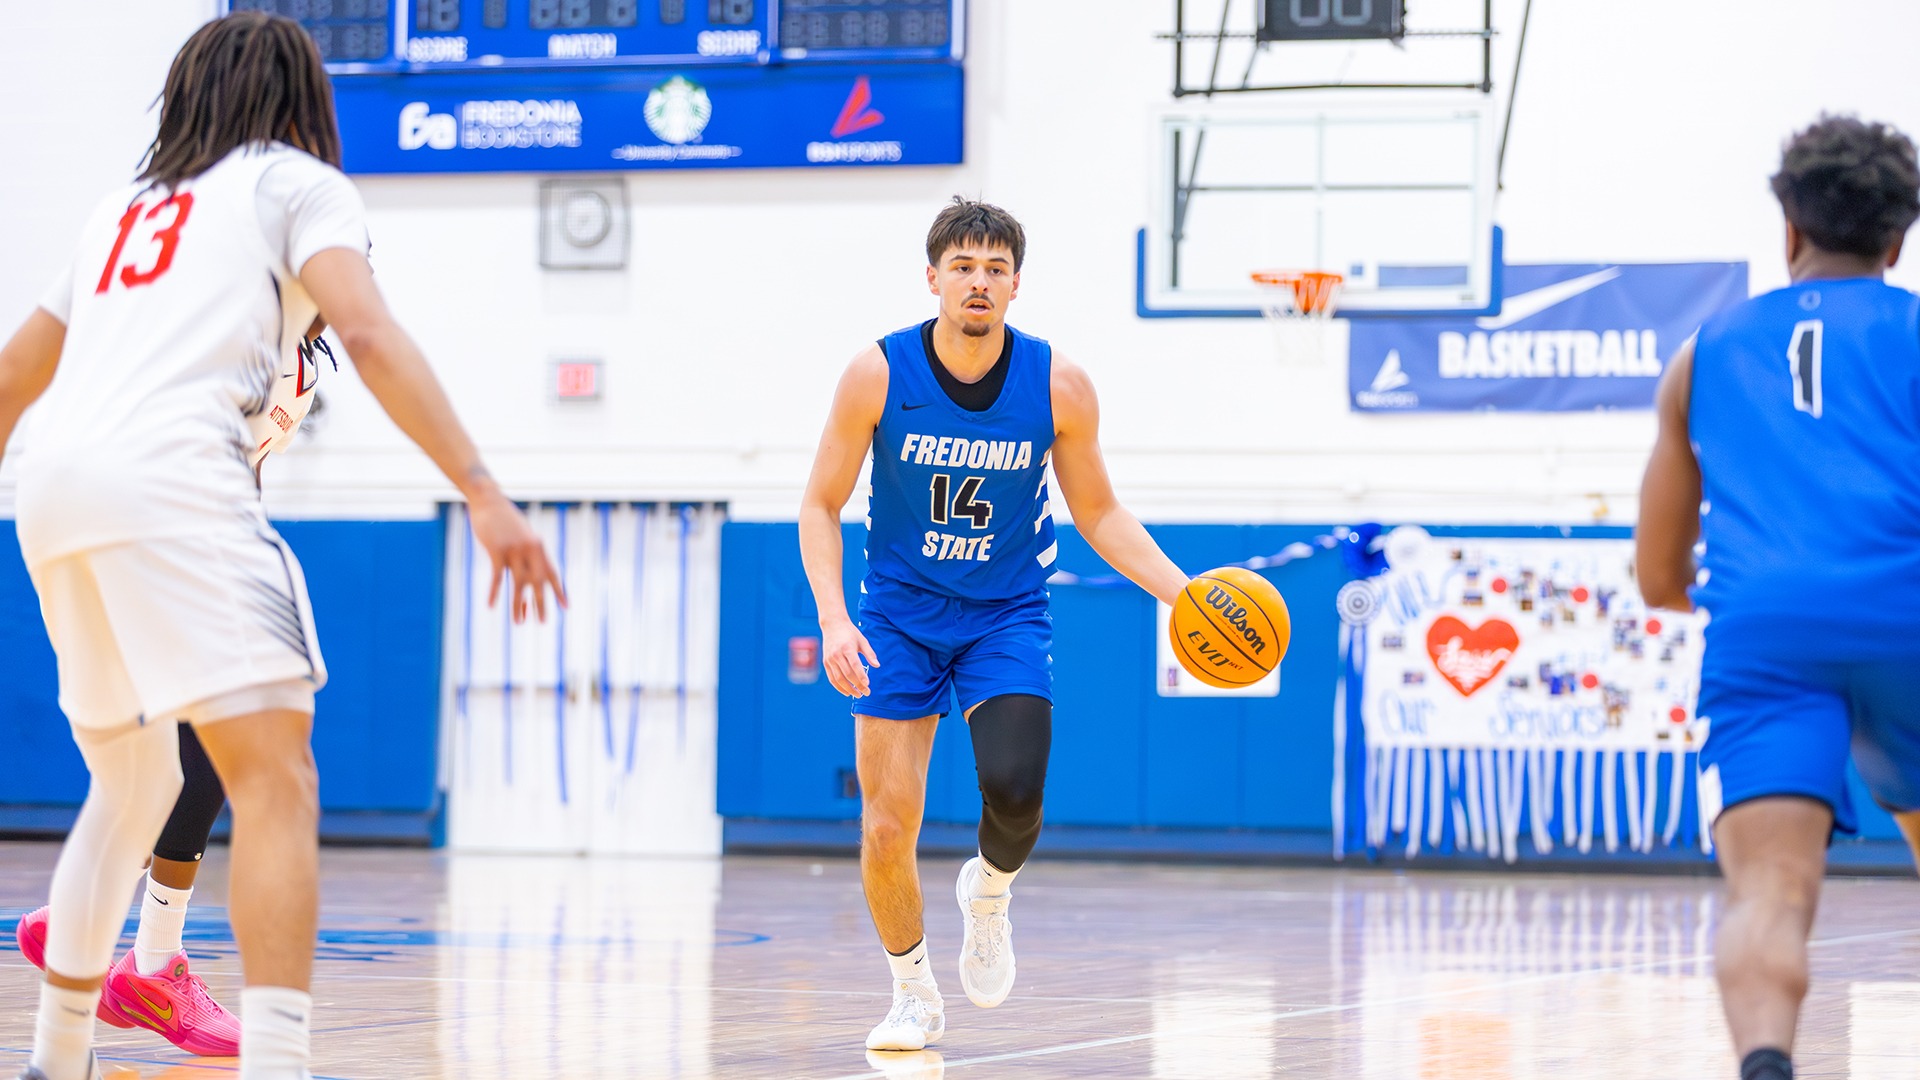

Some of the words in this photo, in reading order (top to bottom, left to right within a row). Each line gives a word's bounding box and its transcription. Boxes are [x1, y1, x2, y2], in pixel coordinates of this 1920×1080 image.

[408, 36, 468, 62] SCORE
[464, 100, 583, 127] FREDONIA
[463, 123, 582, 149] BOOKSTORE
[94, 190, 195, 295] 13
[1438, 329, 1662, 378] BASKETBALL
[1786, 318, 1824, 419] 1
[900, 433, 1032, 471] FREDONIA
[929, 473, 993, 529] 14
[921, 530, 994, 562] STATE
[1205, 585, 1266, 655] Wilson
